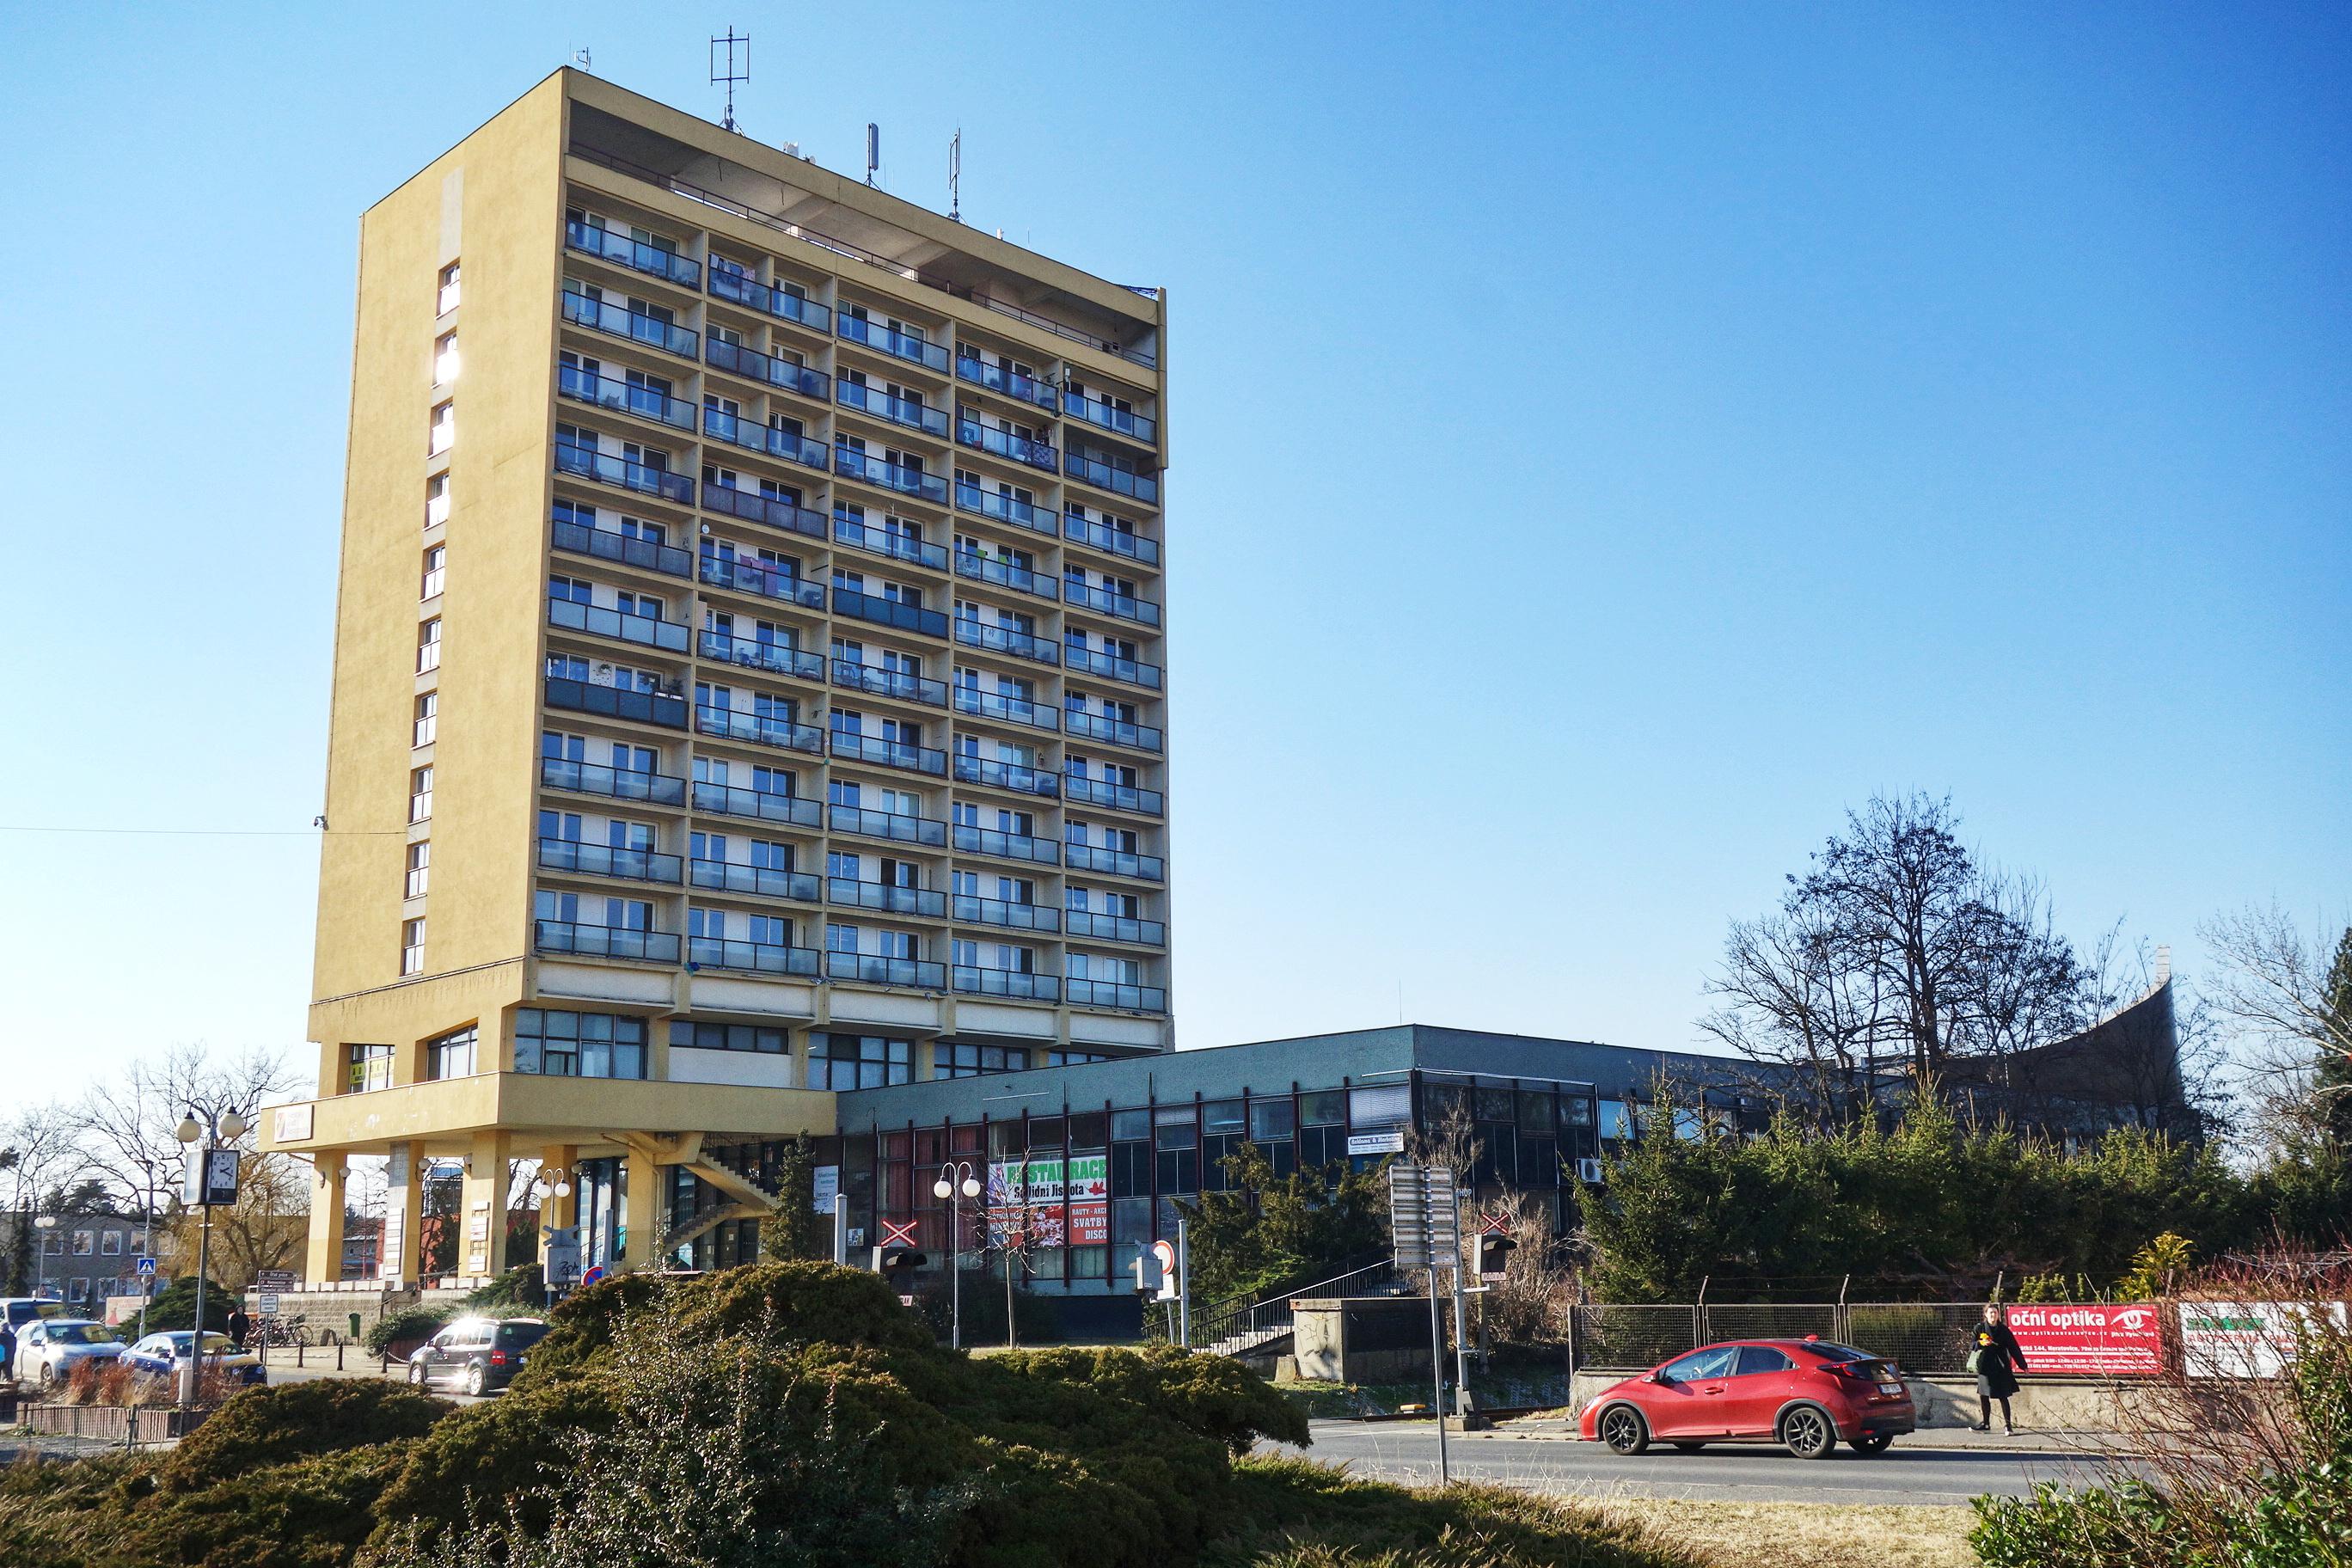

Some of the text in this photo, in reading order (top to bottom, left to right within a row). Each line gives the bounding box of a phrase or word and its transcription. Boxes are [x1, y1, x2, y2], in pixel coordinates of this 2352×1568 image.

[1051, 1183, 1085, 1197] Jisota
[1071, 1207, 1090, 1216] RAUTY
[1073, 1216, 1107, 1228] SVATBY
[2010, 1309, 2106, 1330] oční optika
